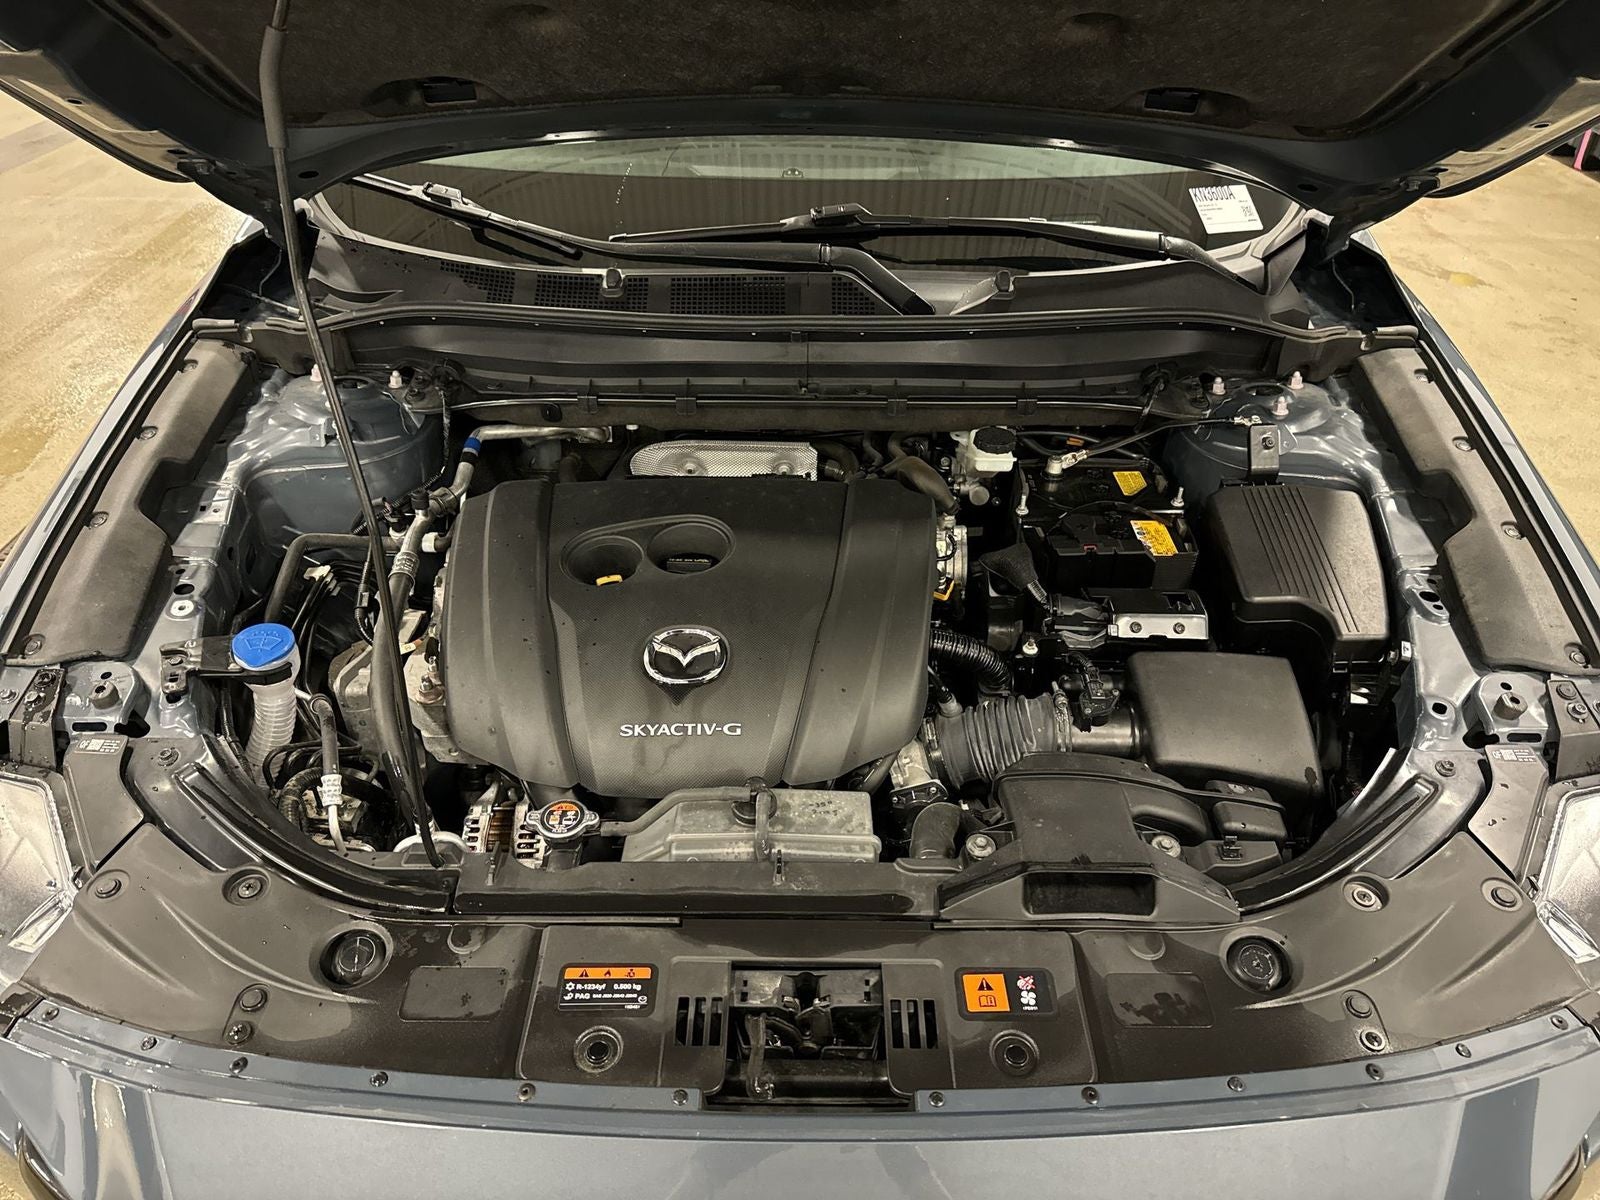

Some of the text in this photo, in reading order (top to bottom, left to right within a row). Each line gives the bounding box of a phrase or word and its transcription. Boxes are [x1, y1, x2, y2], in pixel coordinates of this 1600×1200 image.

[619, 723, 742, 737] SKYACTIV-G
[576, 983, 606, 991] R-1234yf
[632, 983, 642, 991] kg
[574, 992, 591, 1000] PAG
